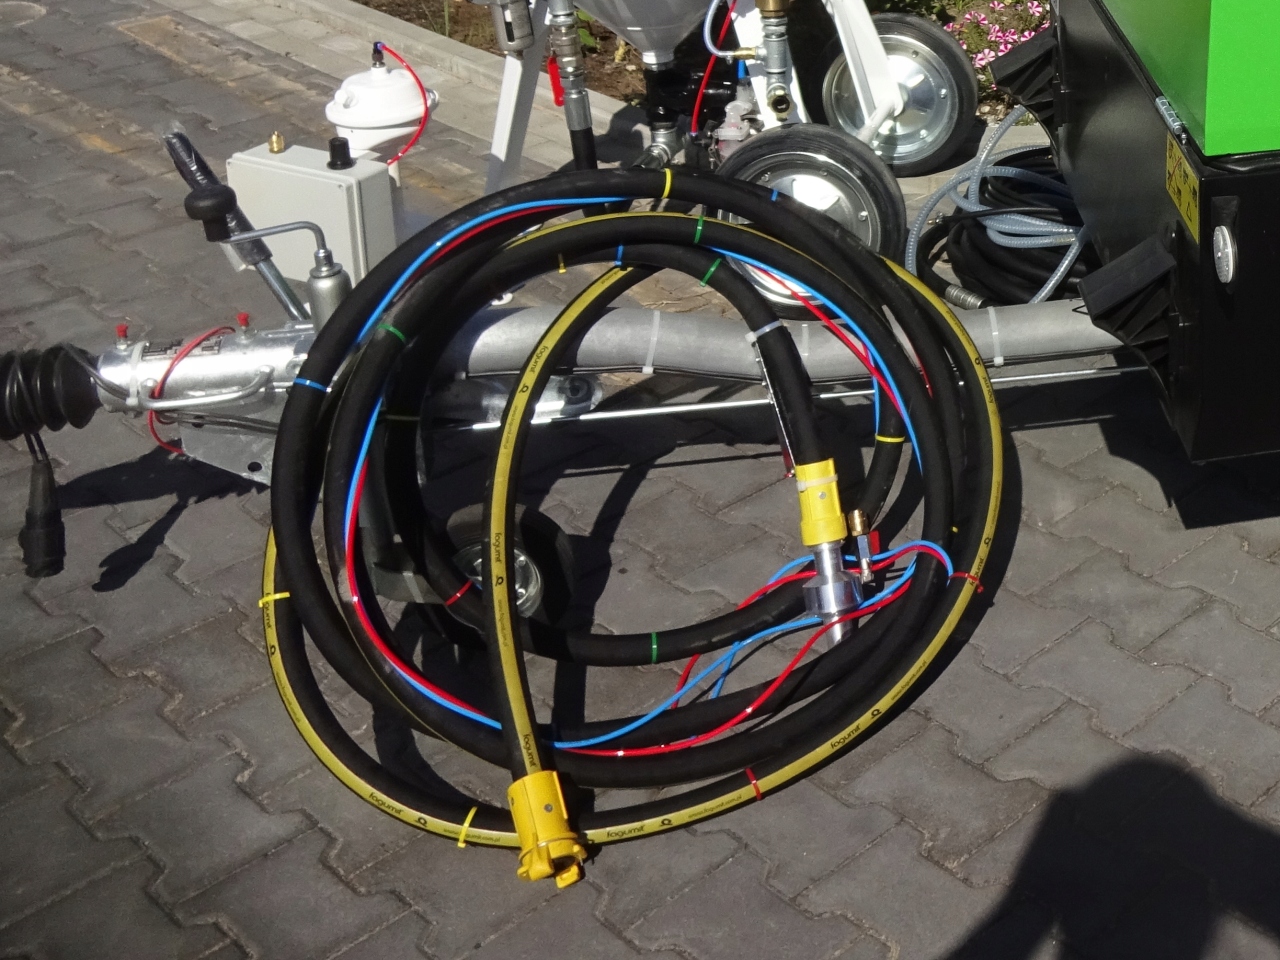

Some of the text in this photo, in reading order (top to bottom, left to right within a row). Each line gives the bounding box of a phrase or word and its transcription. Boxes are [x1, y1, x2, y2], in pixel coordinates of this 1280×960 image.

[830, 722, 861, 750] fagumit
[368, 791, 404, 816] fagumit
[606, 824, 646, 839] fagumit
